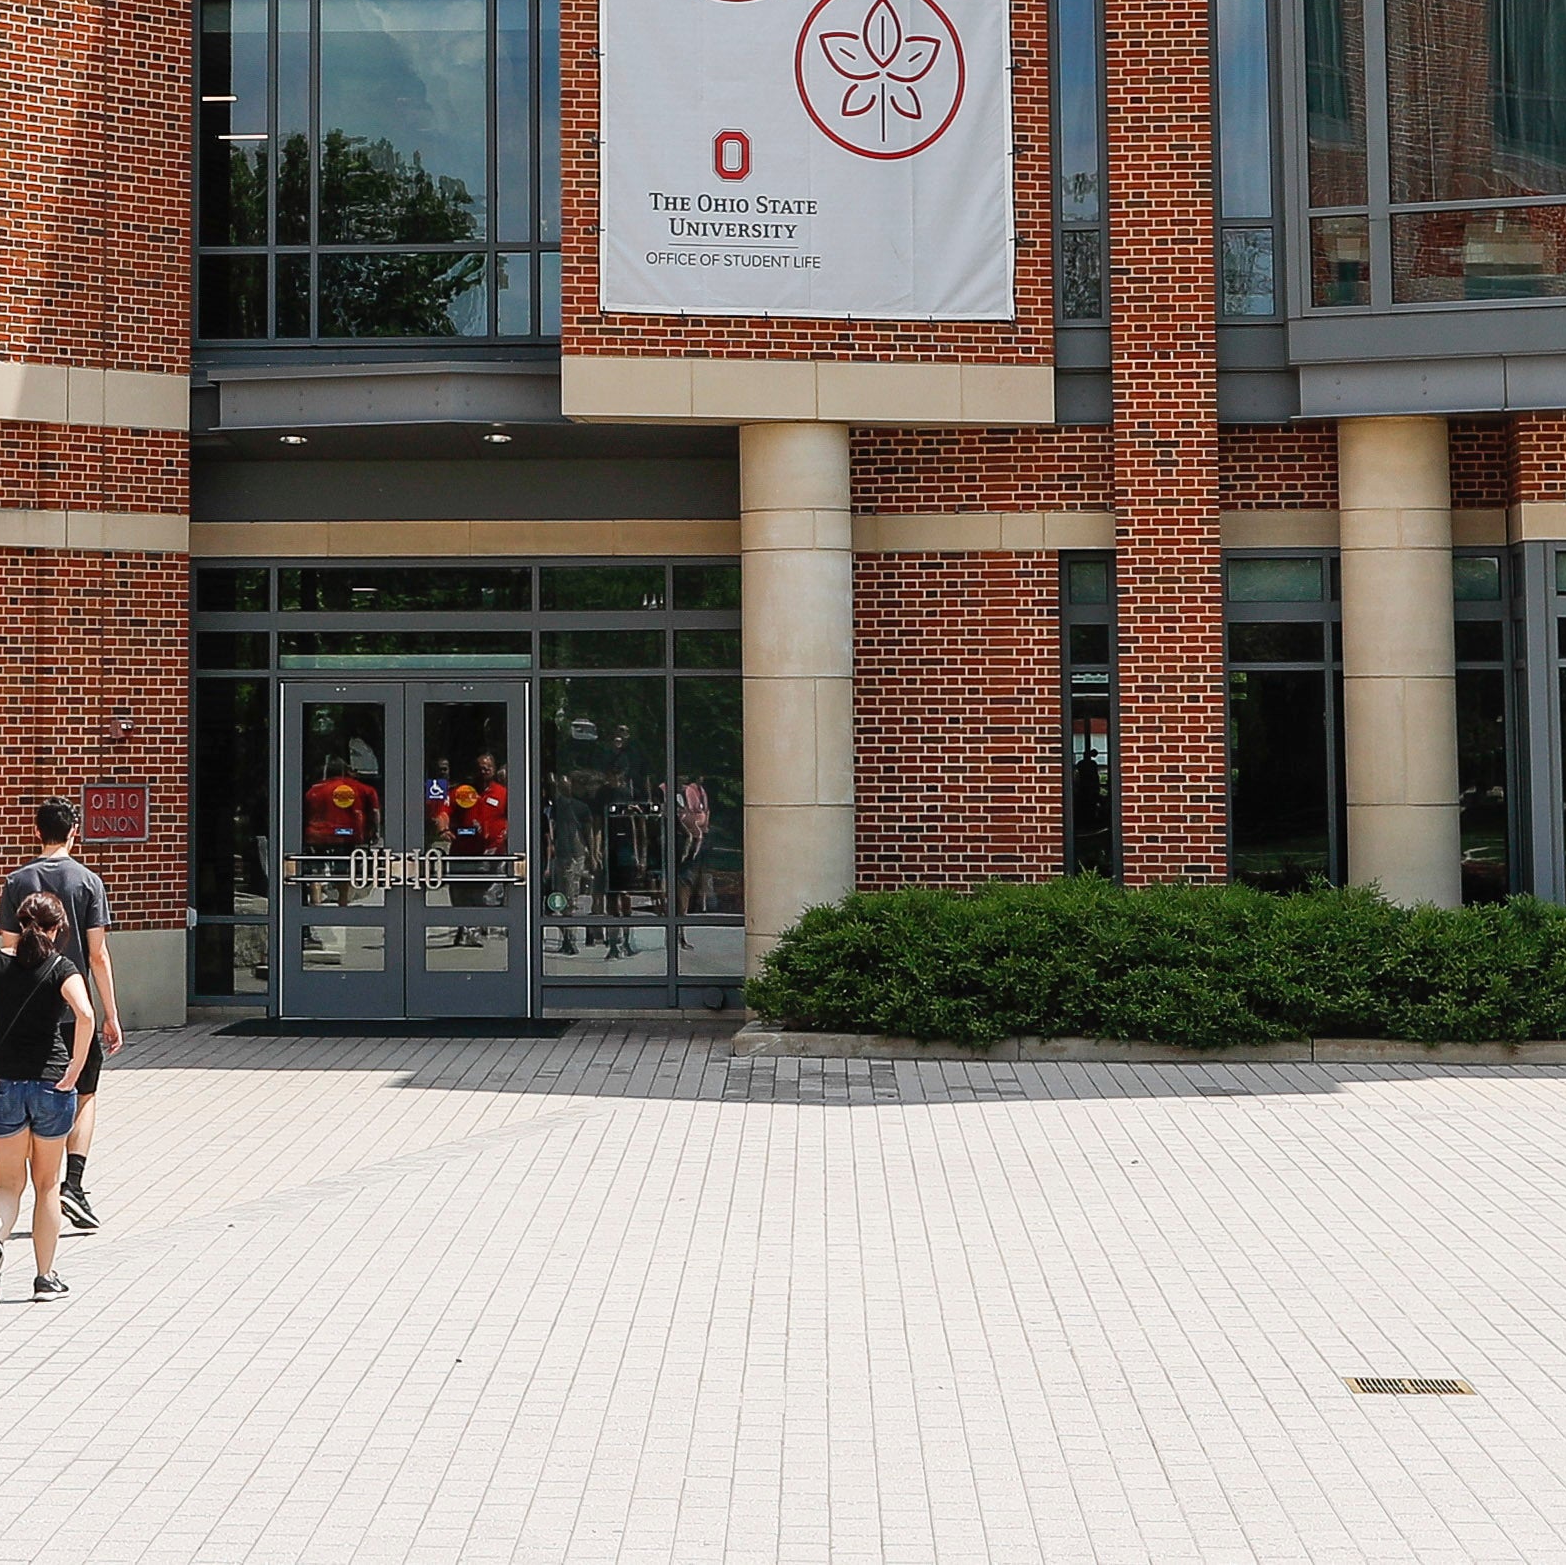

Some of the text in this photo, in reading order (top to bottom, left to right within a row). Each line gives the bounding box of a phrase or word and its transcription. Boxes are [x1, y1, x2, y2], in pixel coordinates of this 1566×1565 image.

[711, 128, 752, 182] O
[646, 252, 821, 269] OFFICE OF STUDENT LIFE
[91, 793, 139, 810] OHIO
[92, 816, 139, 832] UNION
